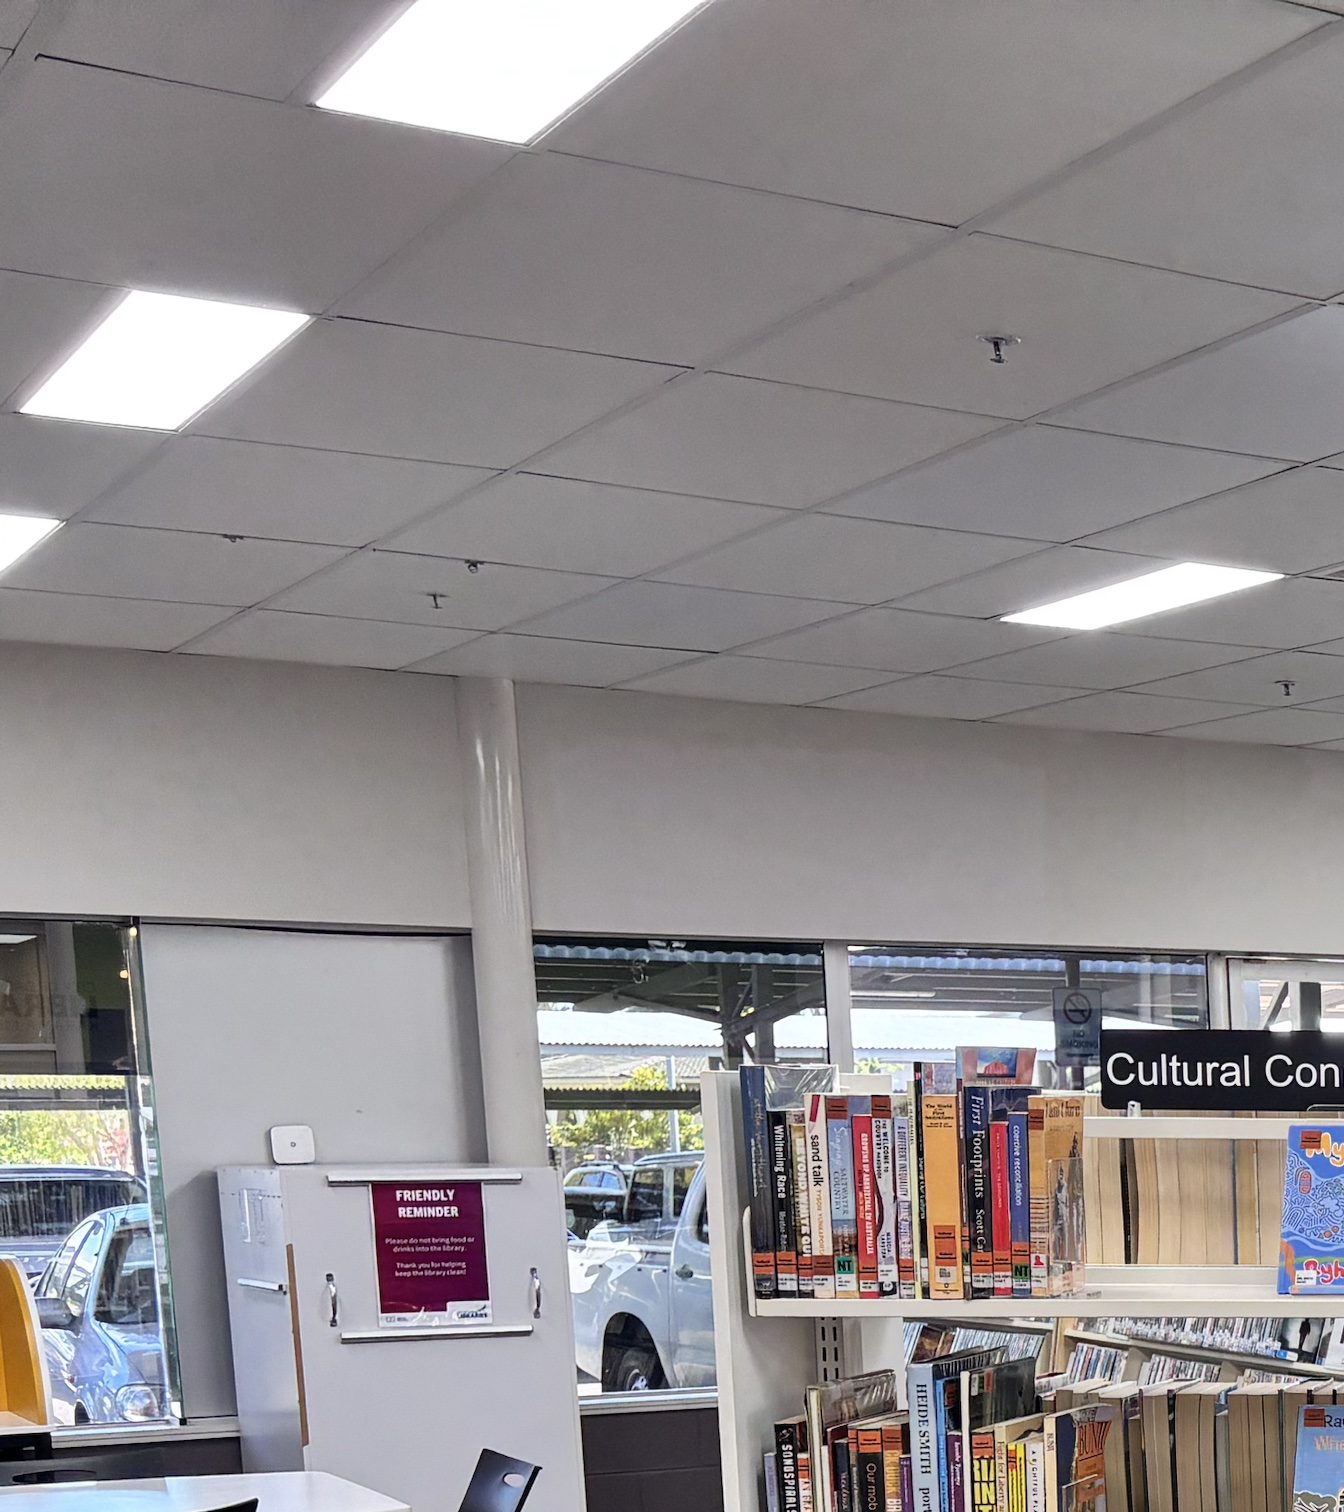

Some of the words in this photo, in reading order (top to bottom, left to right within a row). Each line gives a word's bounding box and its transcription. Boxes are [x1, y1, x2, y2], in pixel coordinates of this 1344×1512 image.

[1106, 1052, 1250, 1087] Cultural
[971, 1095, 983, 1125] First
[773, 1124, 786, 1173] Whitening
[811, 1134, 822, 1162] sand
[812, 1164, 824, 1187] talk
[970, 1129, 988, 1199] Footprints
[396, 1189, 455, 1201] FRIENDLY
[777, 1174, 787, 1199] Race
[1014, 1157, 1023, 1207] reconciliation
[398, 1206, 459, 1218] REMINDER
[432, 1236, 450, 1244] bring
[424, 1269, 446, 1277] library
[916, 1384, 929, 1427] HEIDE
[918, 1428, 932, 1475] SMITH
[867, 1462, 877, 1482] Our
[867, 1485, 878, 1511] mob
